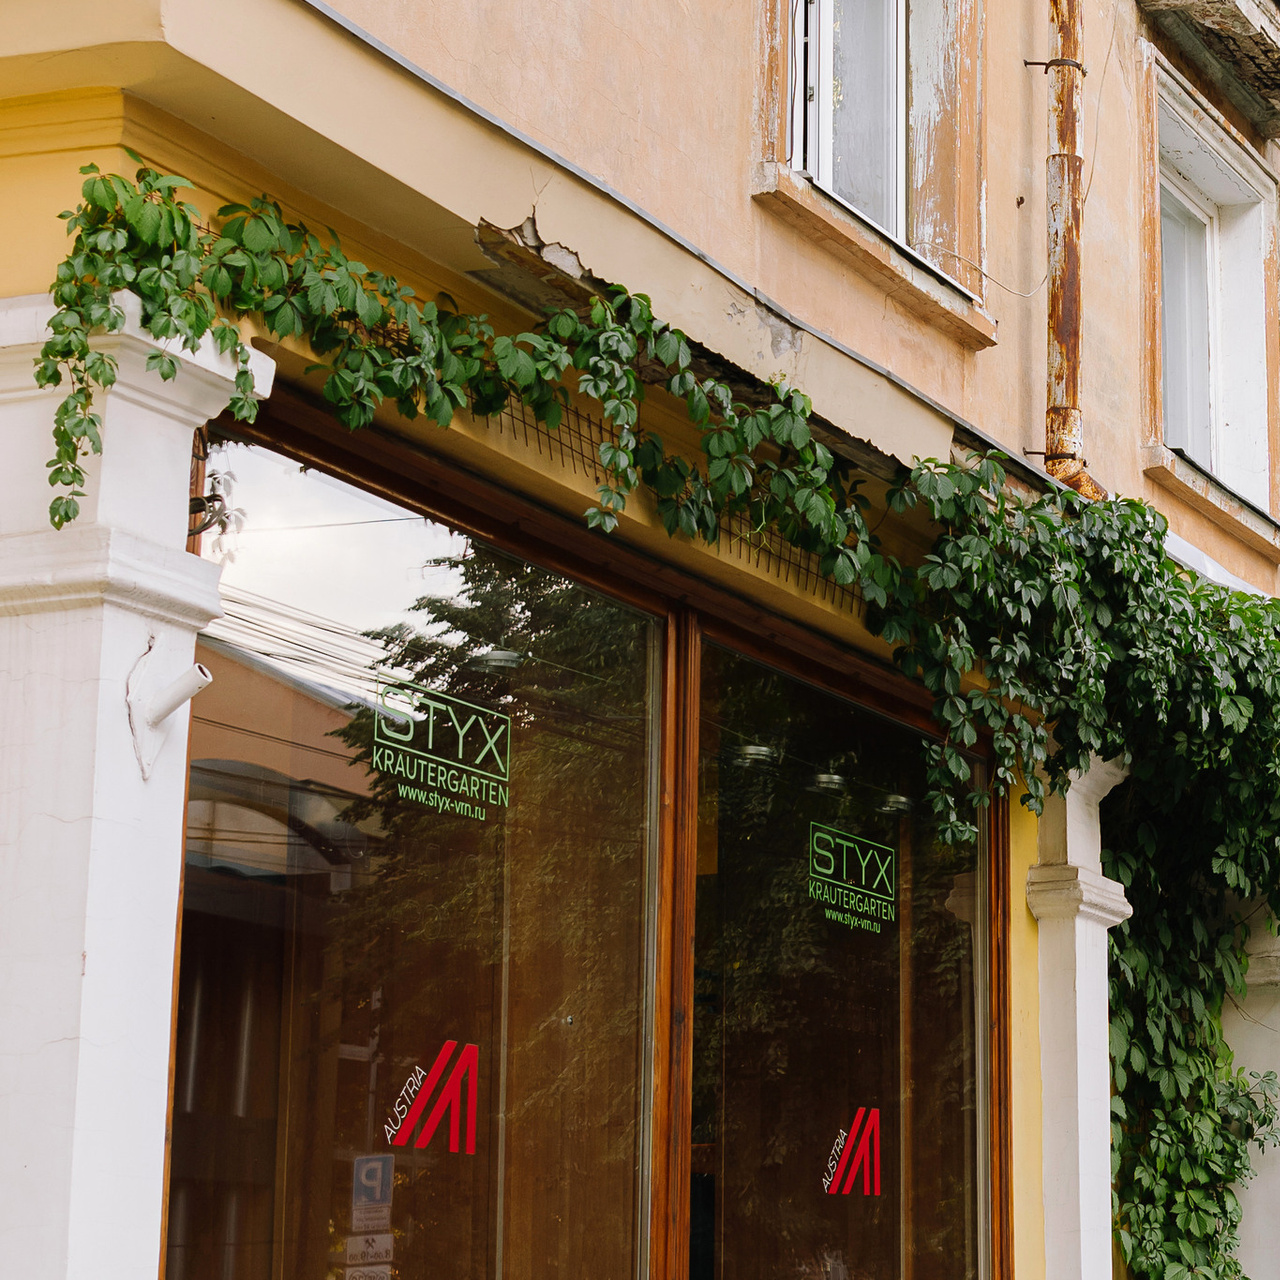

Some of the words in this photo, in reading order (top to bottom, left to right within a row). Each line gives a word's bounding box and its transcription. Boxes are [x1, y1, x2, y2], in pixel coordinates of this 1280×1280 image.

[380, 685, 506, 773] STYX
[372, 745, 509, 808] KRÄUTERGARTEN
[397, 783, 486, 821] www.styx-vrn.ru
[813, 831, 893, 894] STYX
[824, 907, 881, 934] www.styx-vrn.ru
[383, 1065, 427, 1145] AUSTRIA
[822, 1128, 848, 1194] AUSTRIA
